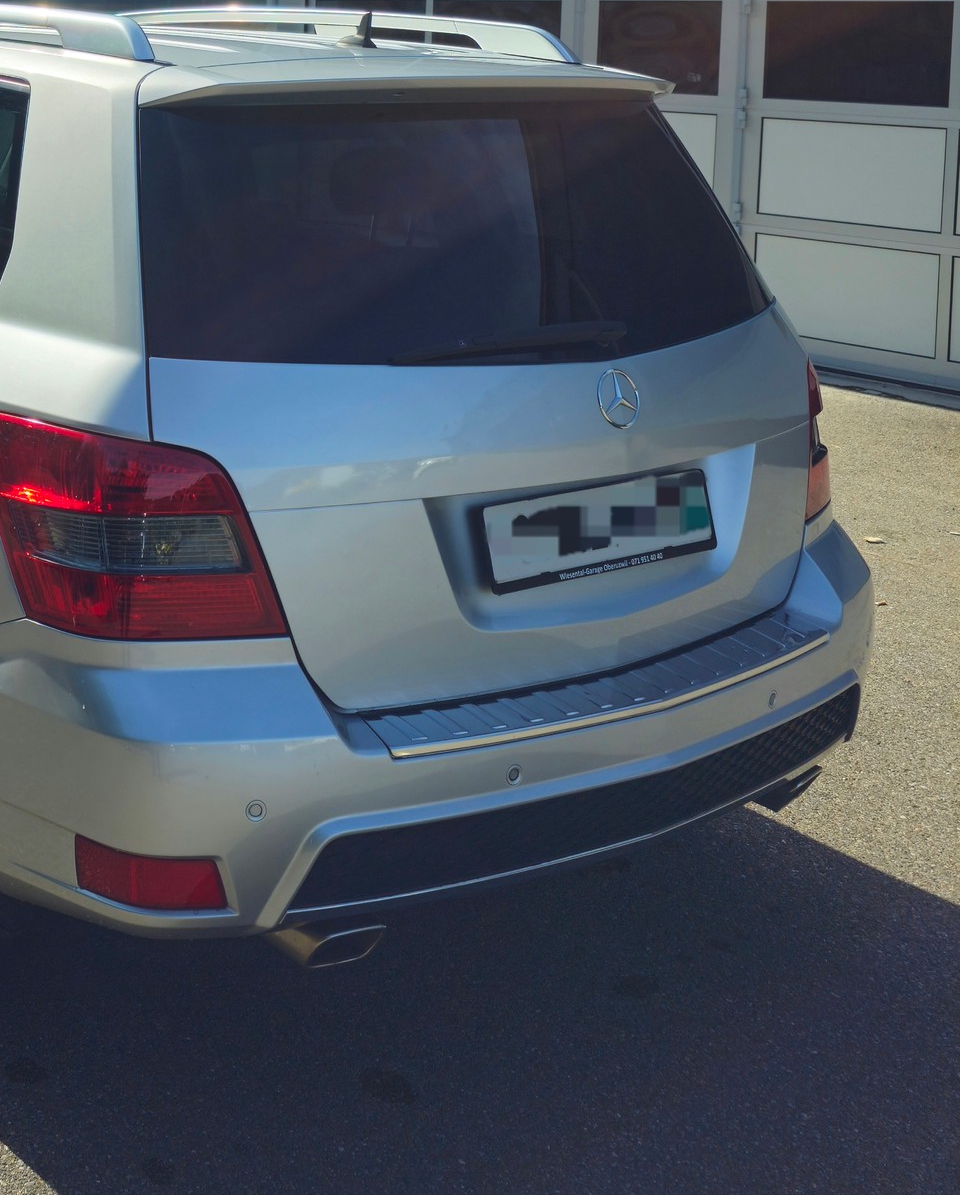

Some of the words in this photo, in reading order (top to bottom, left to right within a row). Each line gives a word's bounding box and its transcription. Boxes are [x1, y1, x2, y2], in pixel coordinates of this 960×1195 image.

[559, 566, 603, 580] Wiesental-Garage
[631, 557, 640, 566] 071
[640, 555, 650, 564] 951
